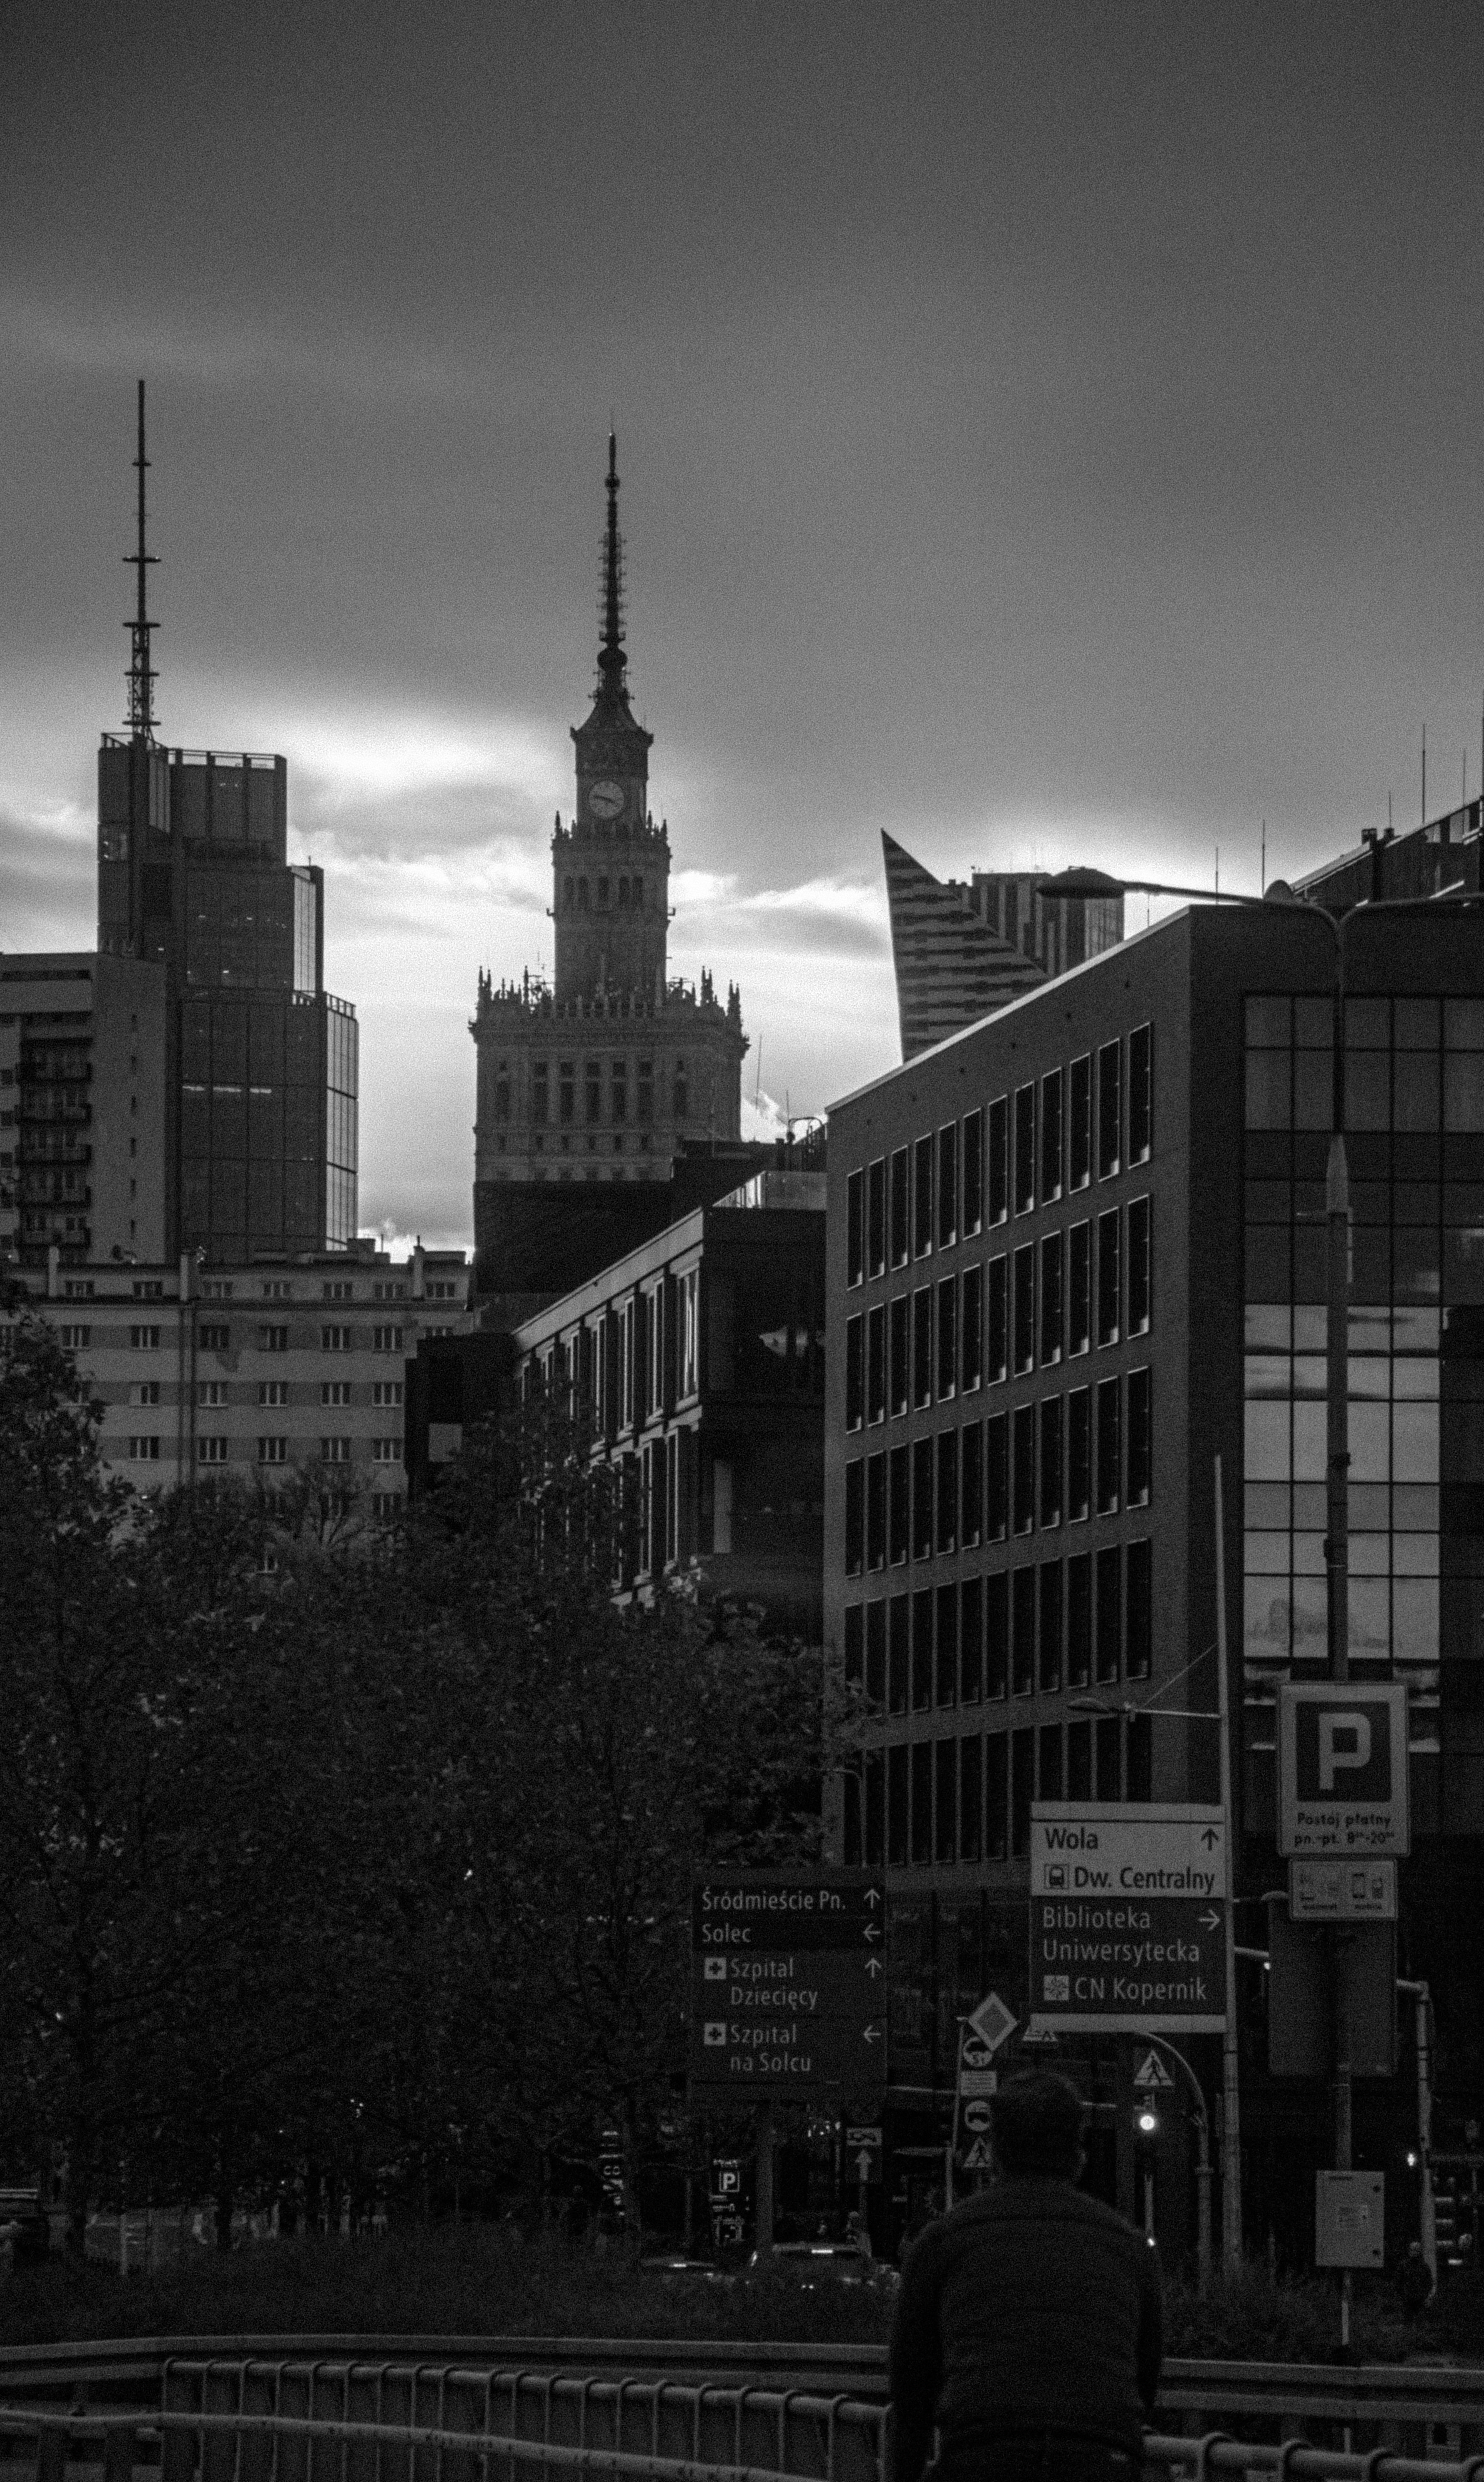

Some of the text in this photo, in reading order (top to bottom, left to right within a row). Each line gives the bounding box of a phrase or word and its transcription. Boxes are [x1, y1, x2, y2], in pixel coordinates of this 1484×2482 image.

[1318, 1712, 1371, 1790] P
[1045, 1828, 1098, 1850] Wola
[1074, 1866, 1215, 1895] Dw. Centralny
[702, 1886, 846, 1911] Śródmieście Pn.
[1043, 1905, 1150, 1929] Biblioteka
[702, 1922, 751, 1943] Solec
[1043, 1938, 1200, 1967] Uniwersytecka
[731, 1957, 794, 1983] Szpital
[731, 1986, 818, 2010] Dziecięcy
[1075, 1976, 1207, 2006] CN Kopernik
[731, 2023, 797, 2049] Szpital
[730, 2051, 811, 2072] na Solcu
[723, 2172, 736, 2190] P
